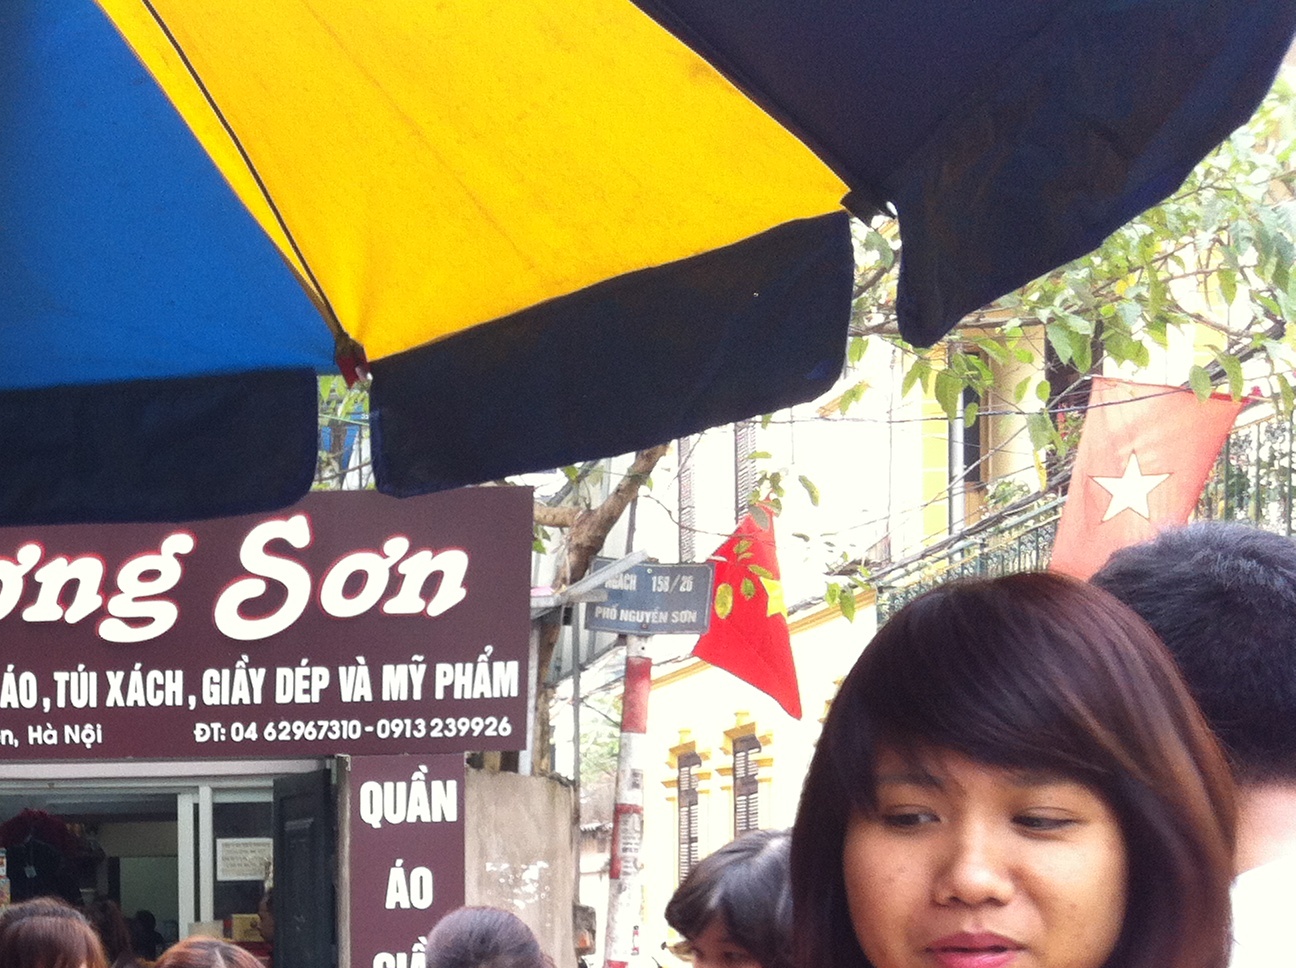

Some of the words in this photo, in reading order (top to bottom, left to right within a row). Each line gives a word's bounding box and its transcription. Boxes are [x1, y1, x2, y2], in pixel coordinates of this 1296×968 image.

[213, 513, 470, 642] Sơn
[54, 663, 98, 709] TÚI
[202, 654, 267, 706] GIẦY
[275, 658, 331, 704] DÉP
[338, 656, 373, 703] VÀ
[381, 656, 428, 702] MỸ
[434, 645, 520, 701] PHẨM
[27, 723, 58, 745] Hà
[63, 722, 103, 749] Nội
[230, 721, 259, 742] 04
[359, 764, 458, 829] QUẦN
[384, 858, 434, 910] ÁO
